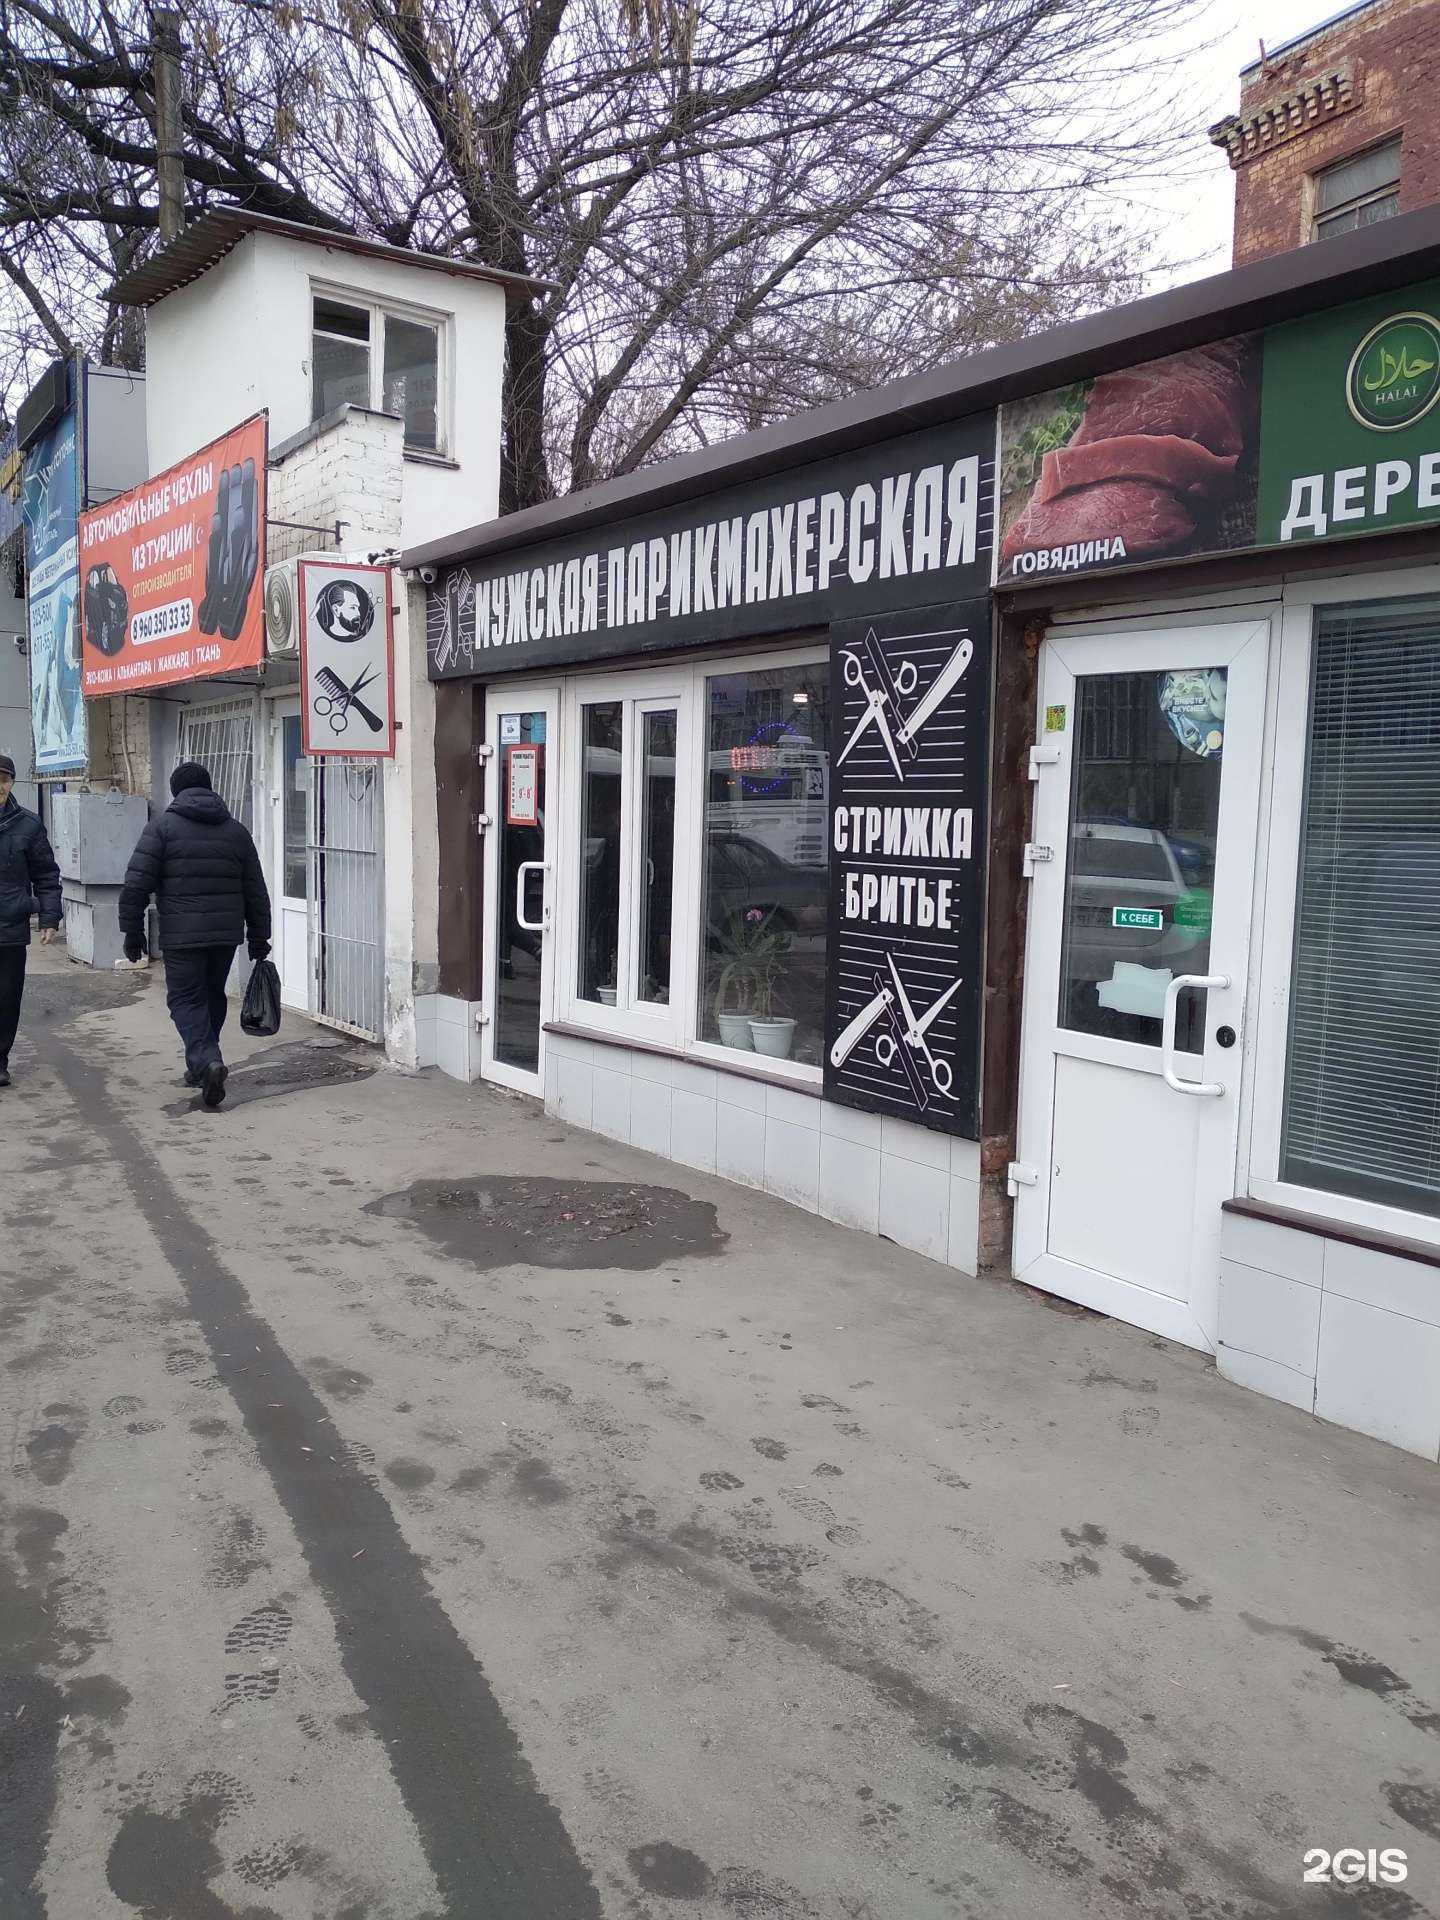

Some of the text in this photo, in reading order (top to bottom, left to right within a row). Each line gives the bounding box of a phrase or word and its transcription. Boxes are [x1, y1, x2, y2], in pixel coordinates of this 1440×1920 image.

[1375, 385, 1419, 406] HALAL
[83, 486, 171, 550] АВТОМОБИЛЬНЫЕ
[172, 462, 214, 507] ЧЕХЛЫ
[131, 523, 193, 573] ИЗ ТУРЦИИ
[475, 455, 980, 650] МУЖСКАЯ ПАРИКМАХЕРСКАЯ
[1012, 536, 1127, 575] ГОВЯДИНА
[140, 563, 193, 597] ПРОИЗВОДИТЕЛЯ
[132, 603, 190, 641] 8 960 350 33 33
[157, 651, 190, 673] ЖАККАРД
[196, 644, 221, 663] ТКАНЬ
[833, 806, 973, 859] СТРИЖКА
[845, 872, 953, 930] БРИТЬЕ
[1120, 912, 1155, 924] К СЕБЕ
